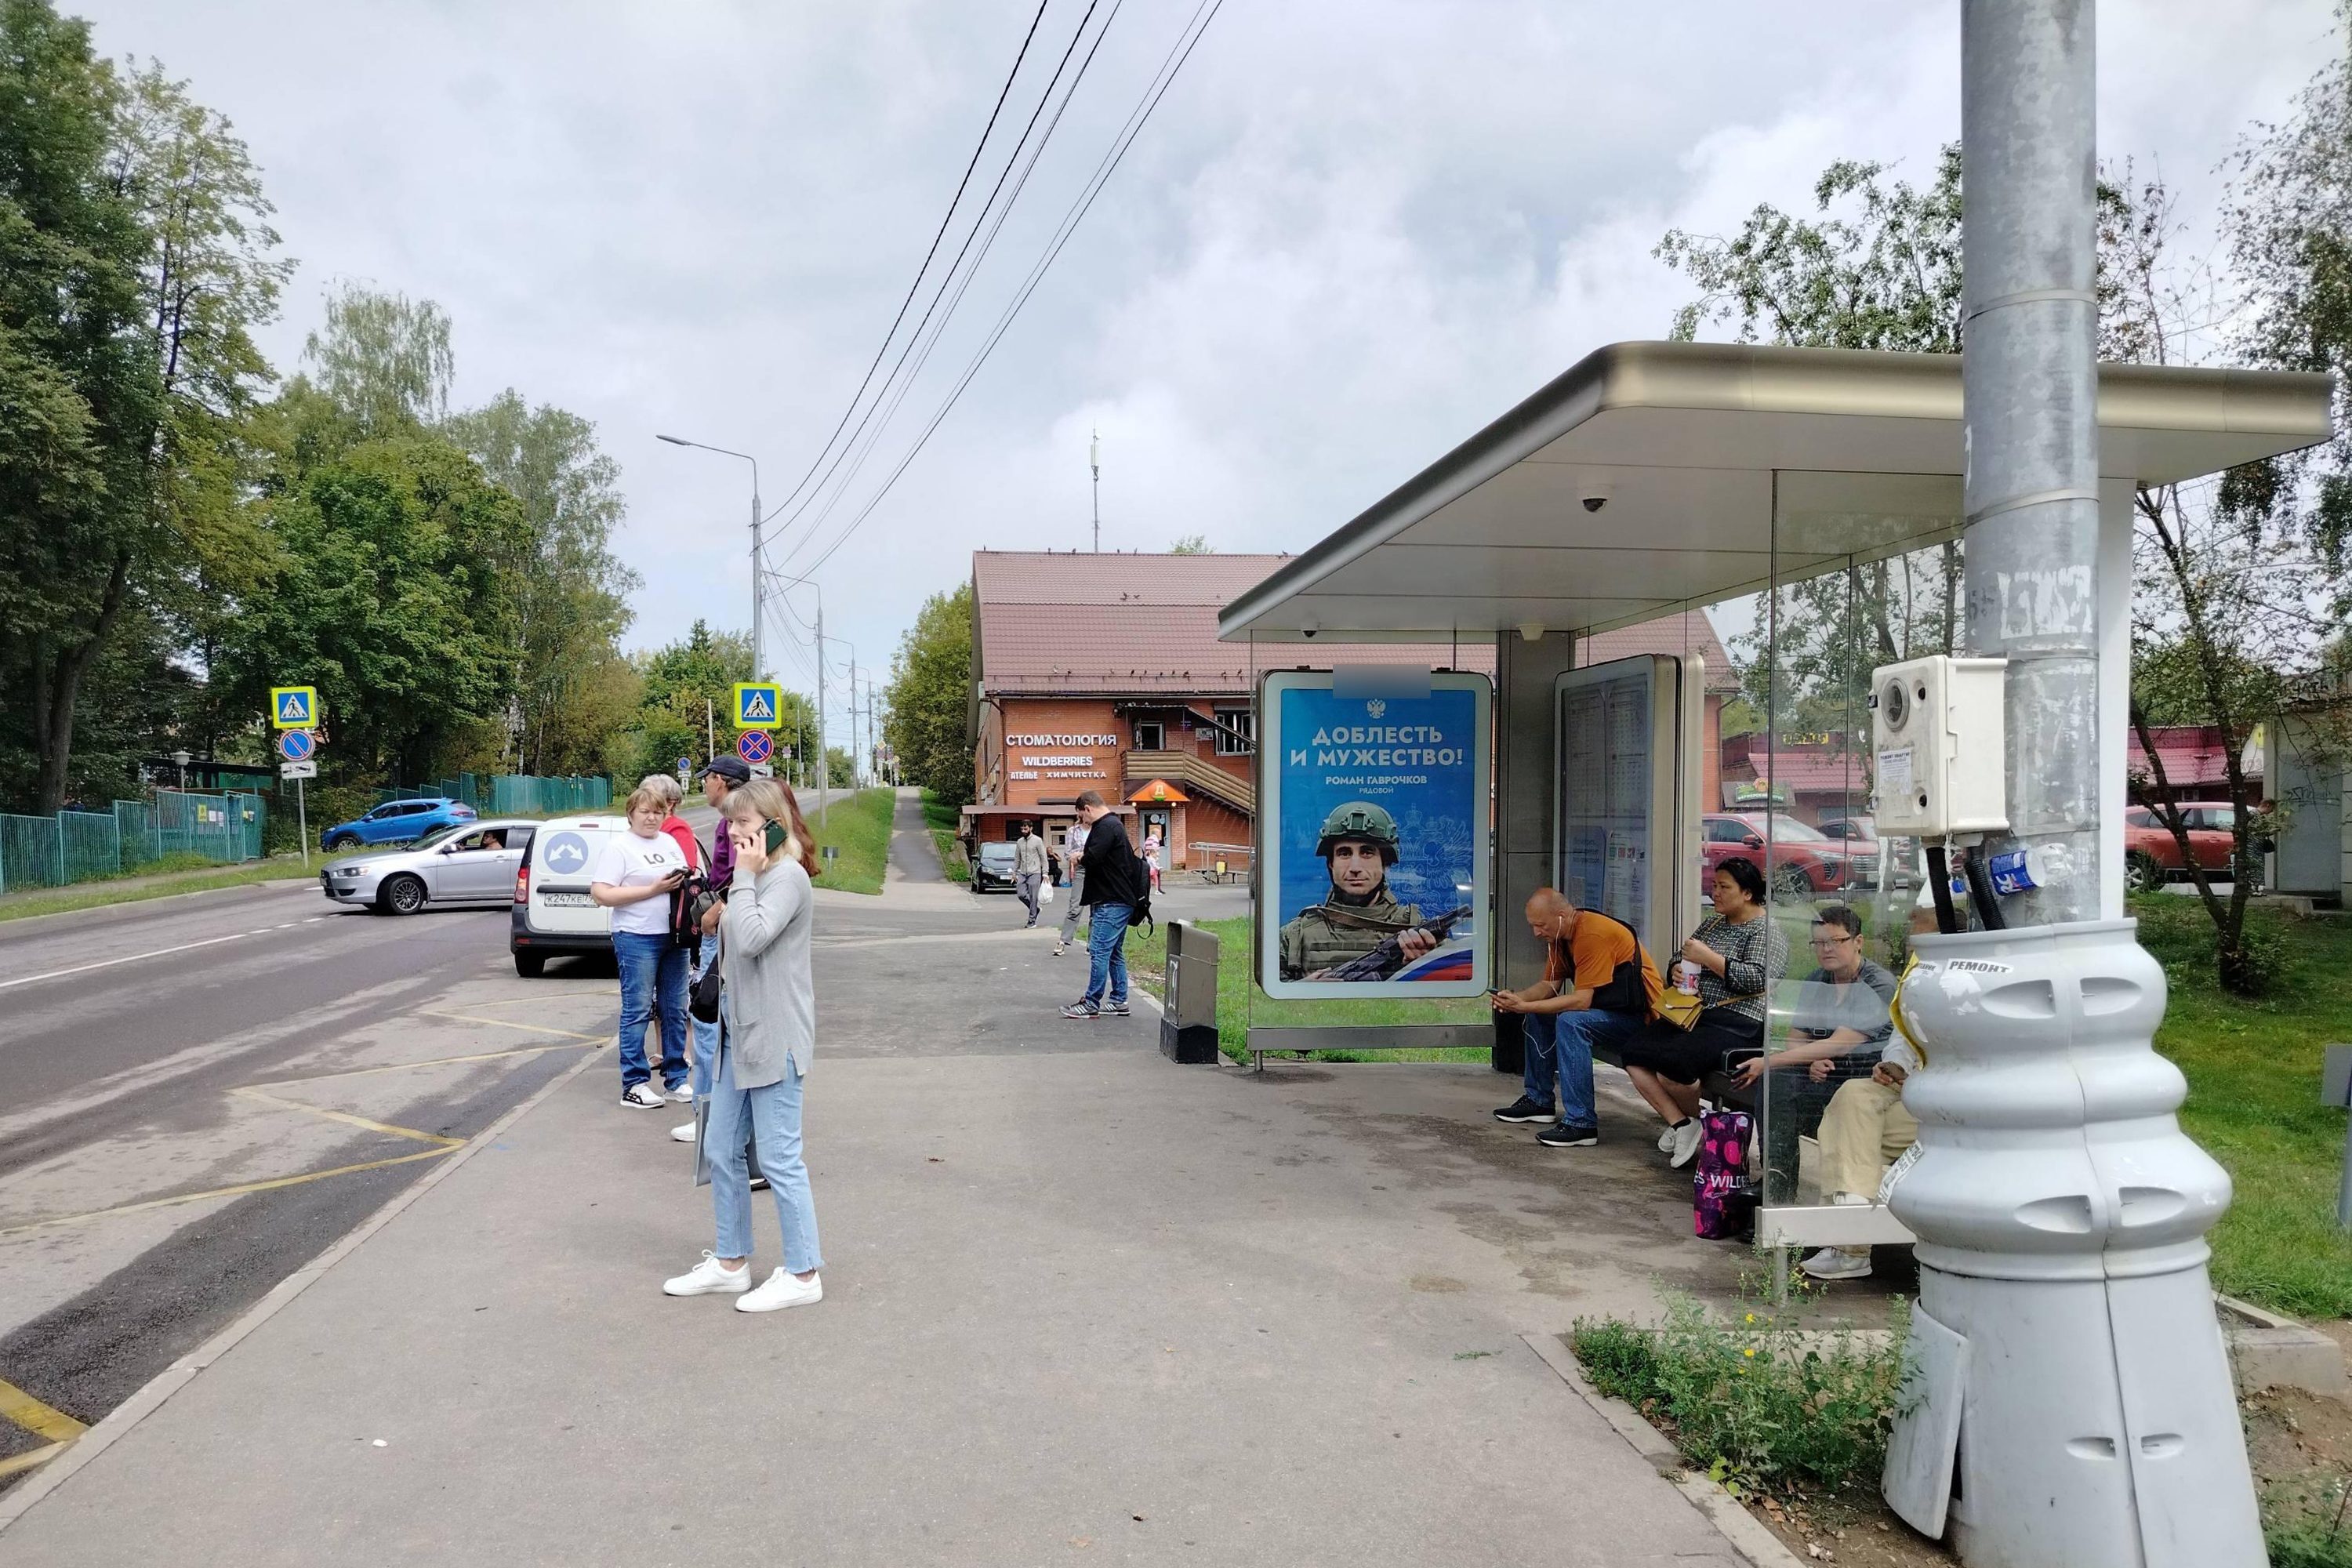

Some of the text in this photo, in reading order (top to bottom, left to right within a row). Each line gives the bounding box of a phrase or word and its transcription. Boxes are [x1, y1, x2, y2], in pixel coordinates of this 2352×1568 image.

[1006, 735, 1116, 746] СТОМАТОЛОГИЯ
[1312, 727, 1443, 746] ДОБЛЕСТЬ
[1022, 756, 1093, 766] WILDBERRIES
[1290, 749, 1463, 766] И МУЖЕСТВО!
[1326, 775, 1428, 785] РОМАН ГАВРОЧКОВ
[1949, 960, 2009, 973] РЕМОНТ
